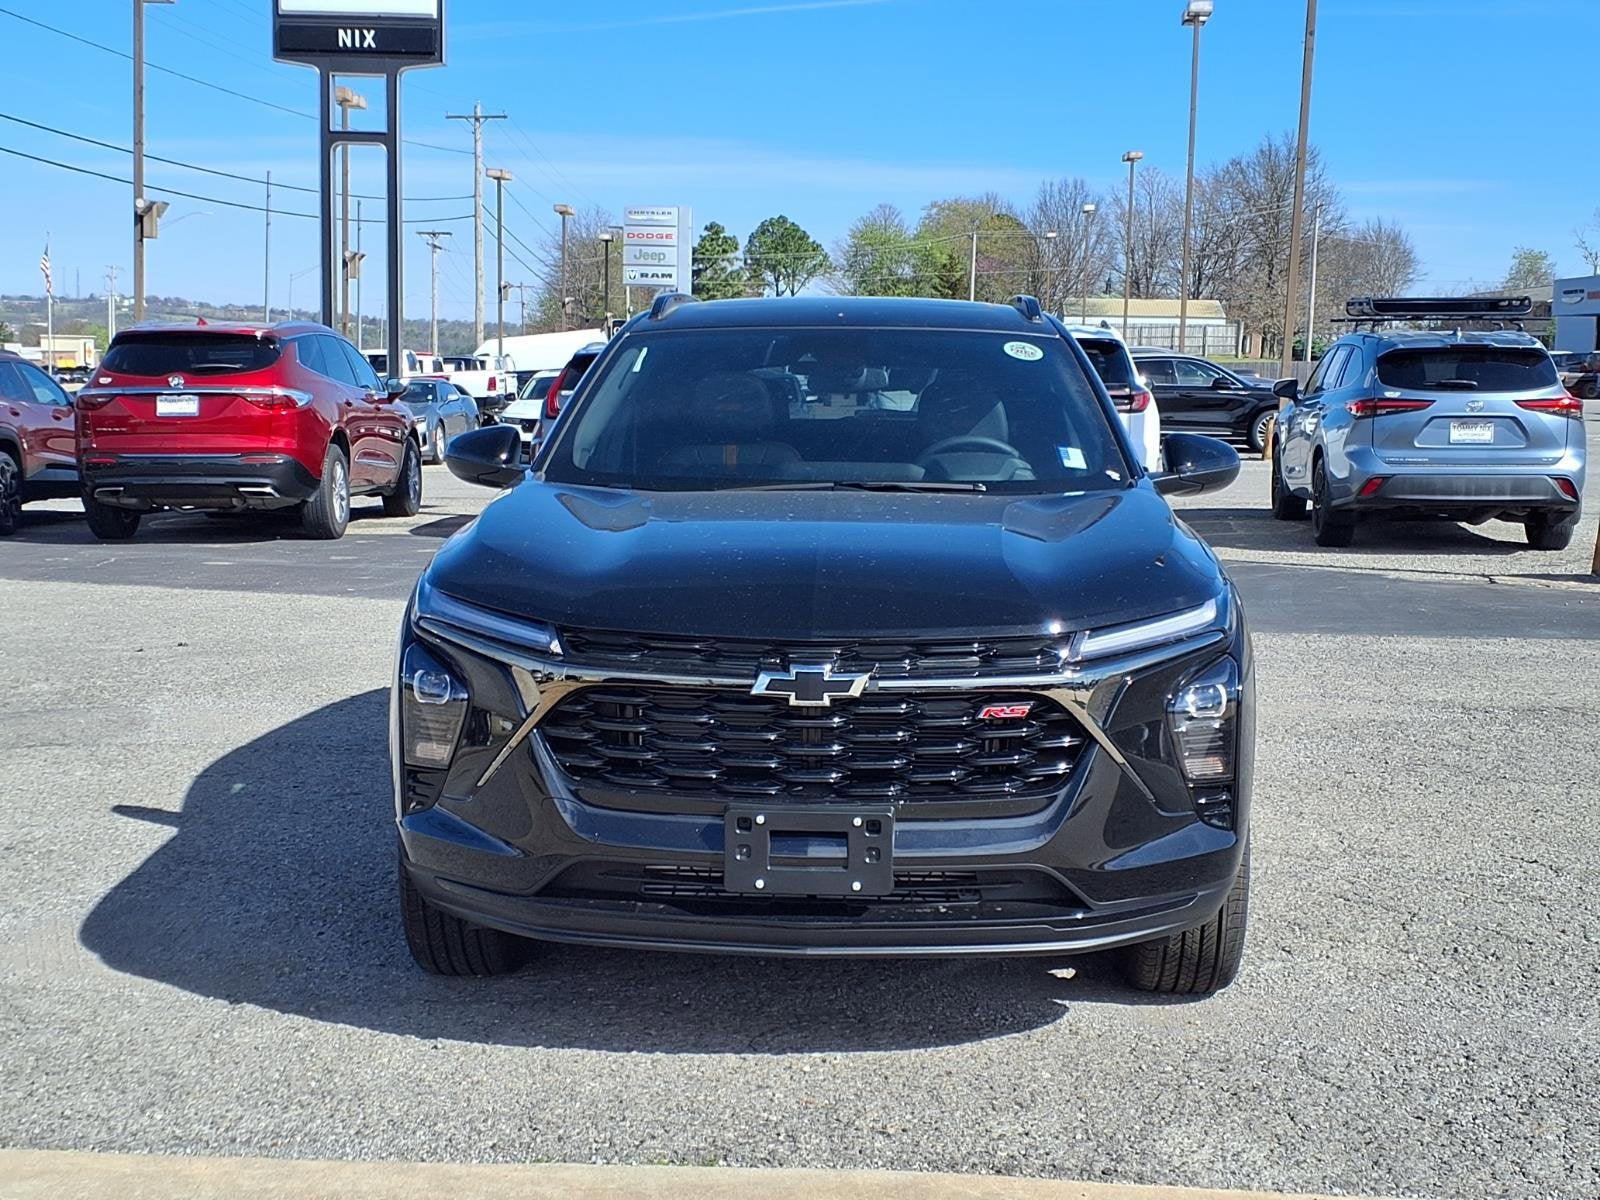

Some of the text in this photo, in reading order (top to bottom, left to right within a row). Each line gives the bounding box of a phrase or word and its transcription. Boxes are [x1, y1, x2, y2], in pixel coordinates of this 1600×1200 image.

[338, 28, 376, 48] NIX
[626, 232, 673, 240] DODGE
[633, 248, 666, 262] Jeep
[977, 705, 1031, 718] RS
